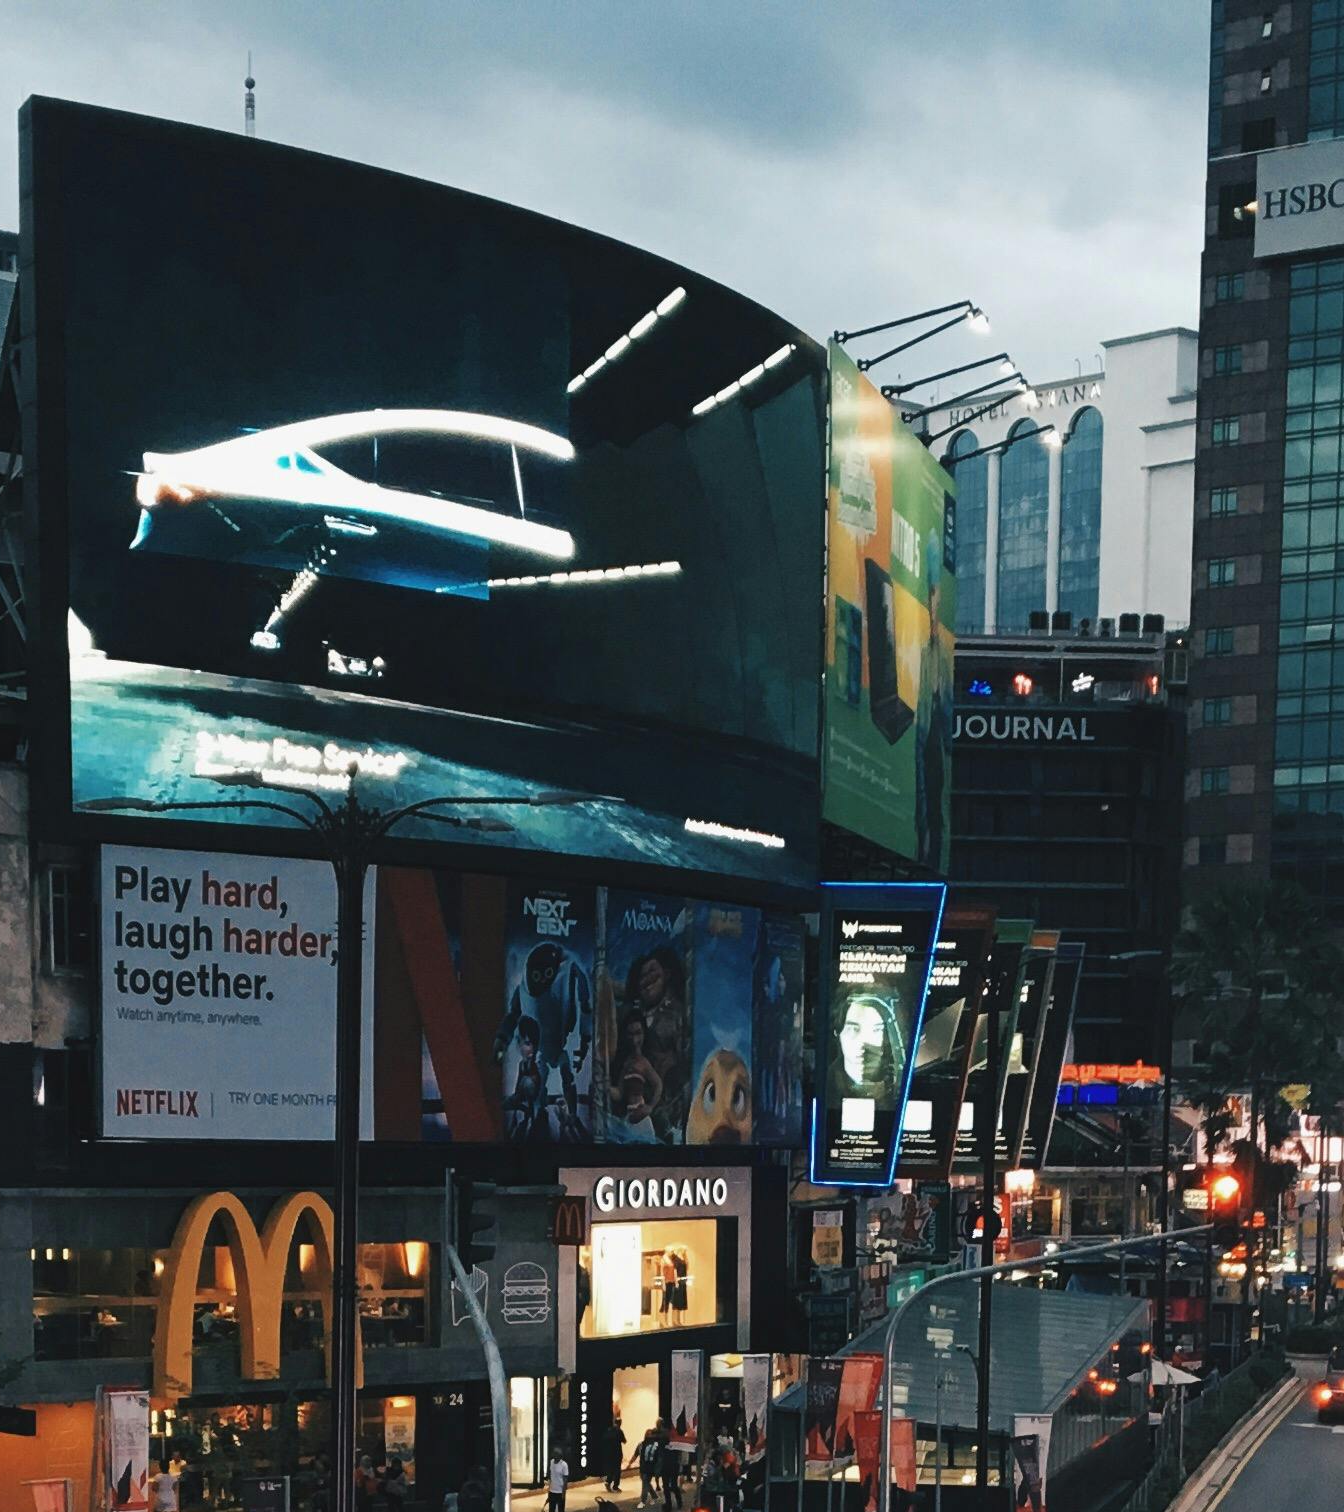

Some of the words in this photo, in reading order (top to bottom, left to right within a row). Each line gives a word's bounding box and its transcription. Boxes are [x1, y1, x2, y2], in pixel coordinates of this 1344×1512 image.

[952, 715, 1095, 741] JOURNAL
[114, 864, 192, 913] Play
[202, 869, 288, 919] hard,
[523, 896, 572, 919] NEXT
[536, 916, 578, 937] GEN
[622, 906, 676, 938] MOANA
[114, 911, 213, 960] laugh
[223, 917, 338, 967] harder,
[114, 960, 275, 1006] together.
[116, 1006, 154, 1022] Watch
[156, 1009, 204, 1025] anytime,
[207, 1011, 263, 1026] anywhere.
[116, 1088, 199, 1118] NETFLIX
[228, 1091, 251, 1105] TRY
[255, 1092, 279, 1106] ONE
[281, 1092, 324, 1107] MONTH
[594, 1175, 729, 1213] GIORDANO
[449, 1393, 464, 1406] 24
